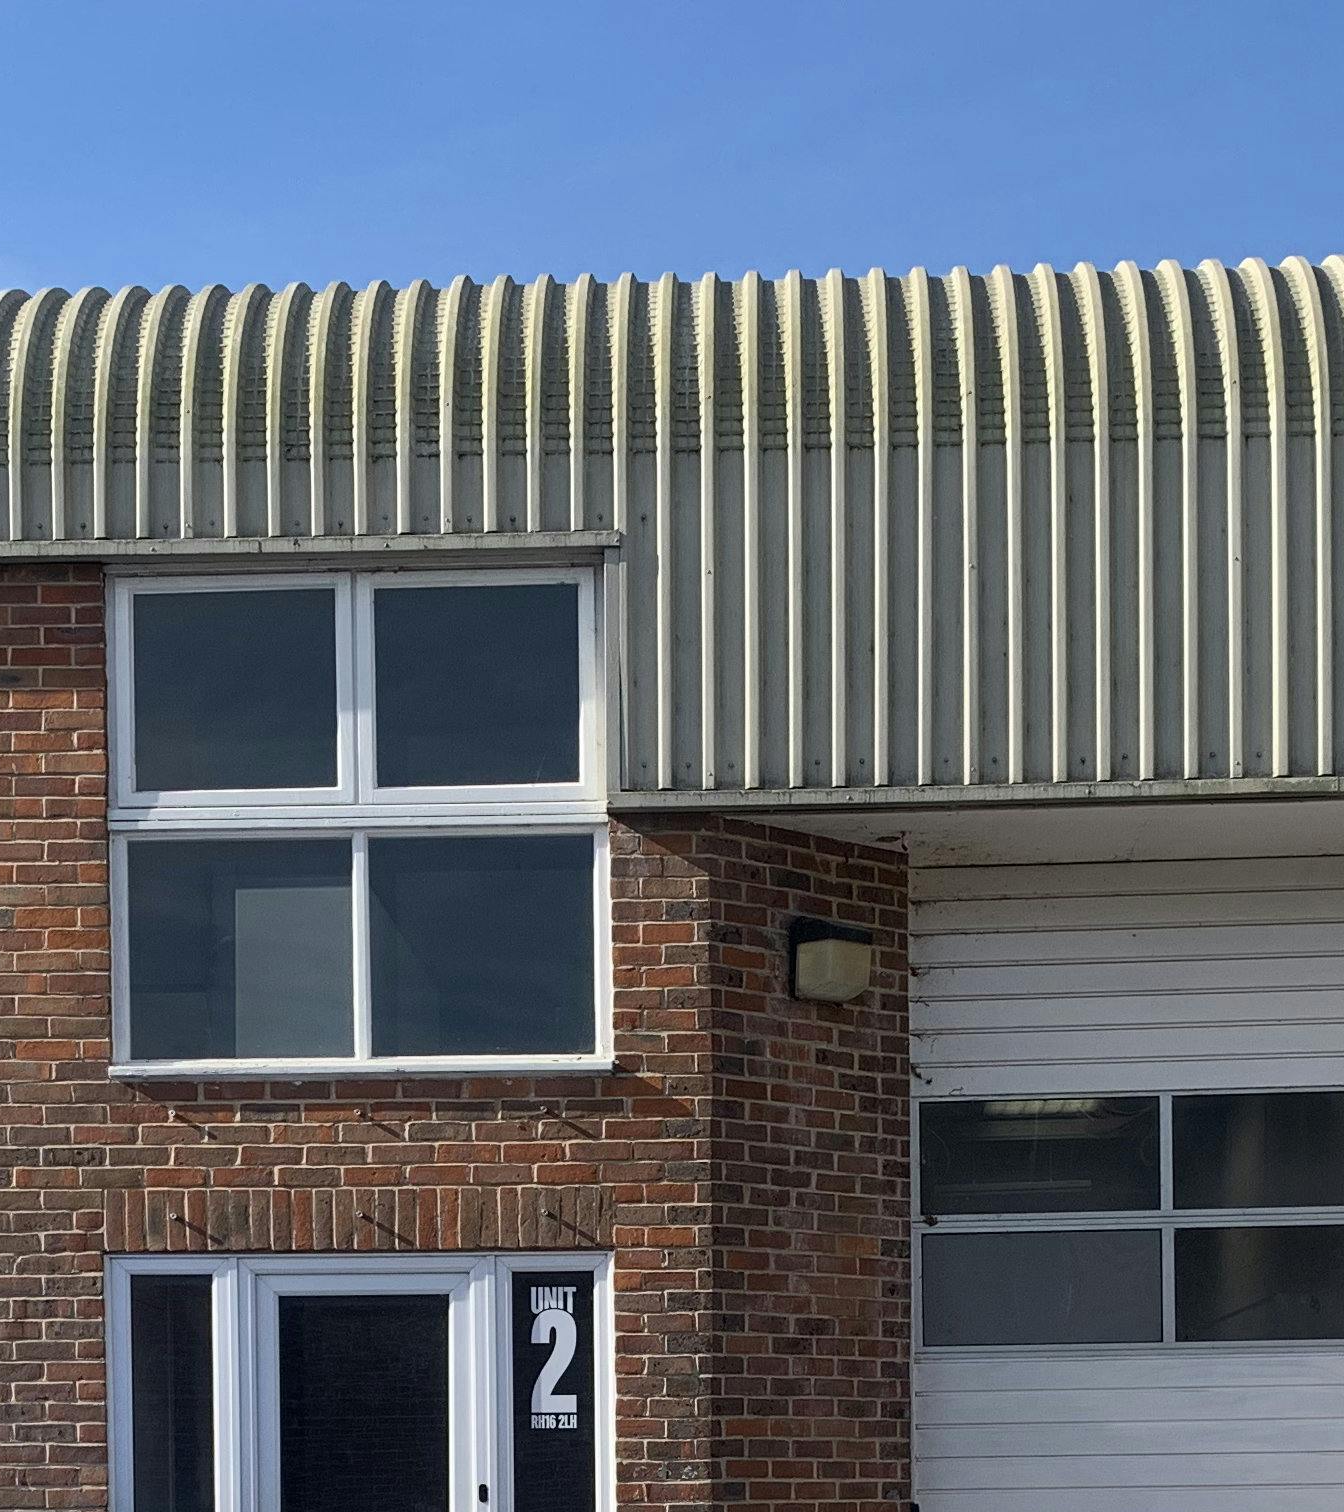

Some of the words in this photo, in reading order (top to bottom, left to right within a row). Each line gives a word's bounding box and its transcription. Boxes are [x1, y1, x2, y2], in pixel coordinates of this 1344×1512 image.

[530, 1286, 577, 1315] UNIT
[530, 1308, 577, 1414] 2
[530, 1414, 557, 1430] RH16
[558, 1414, 578, 1430] 2LH
